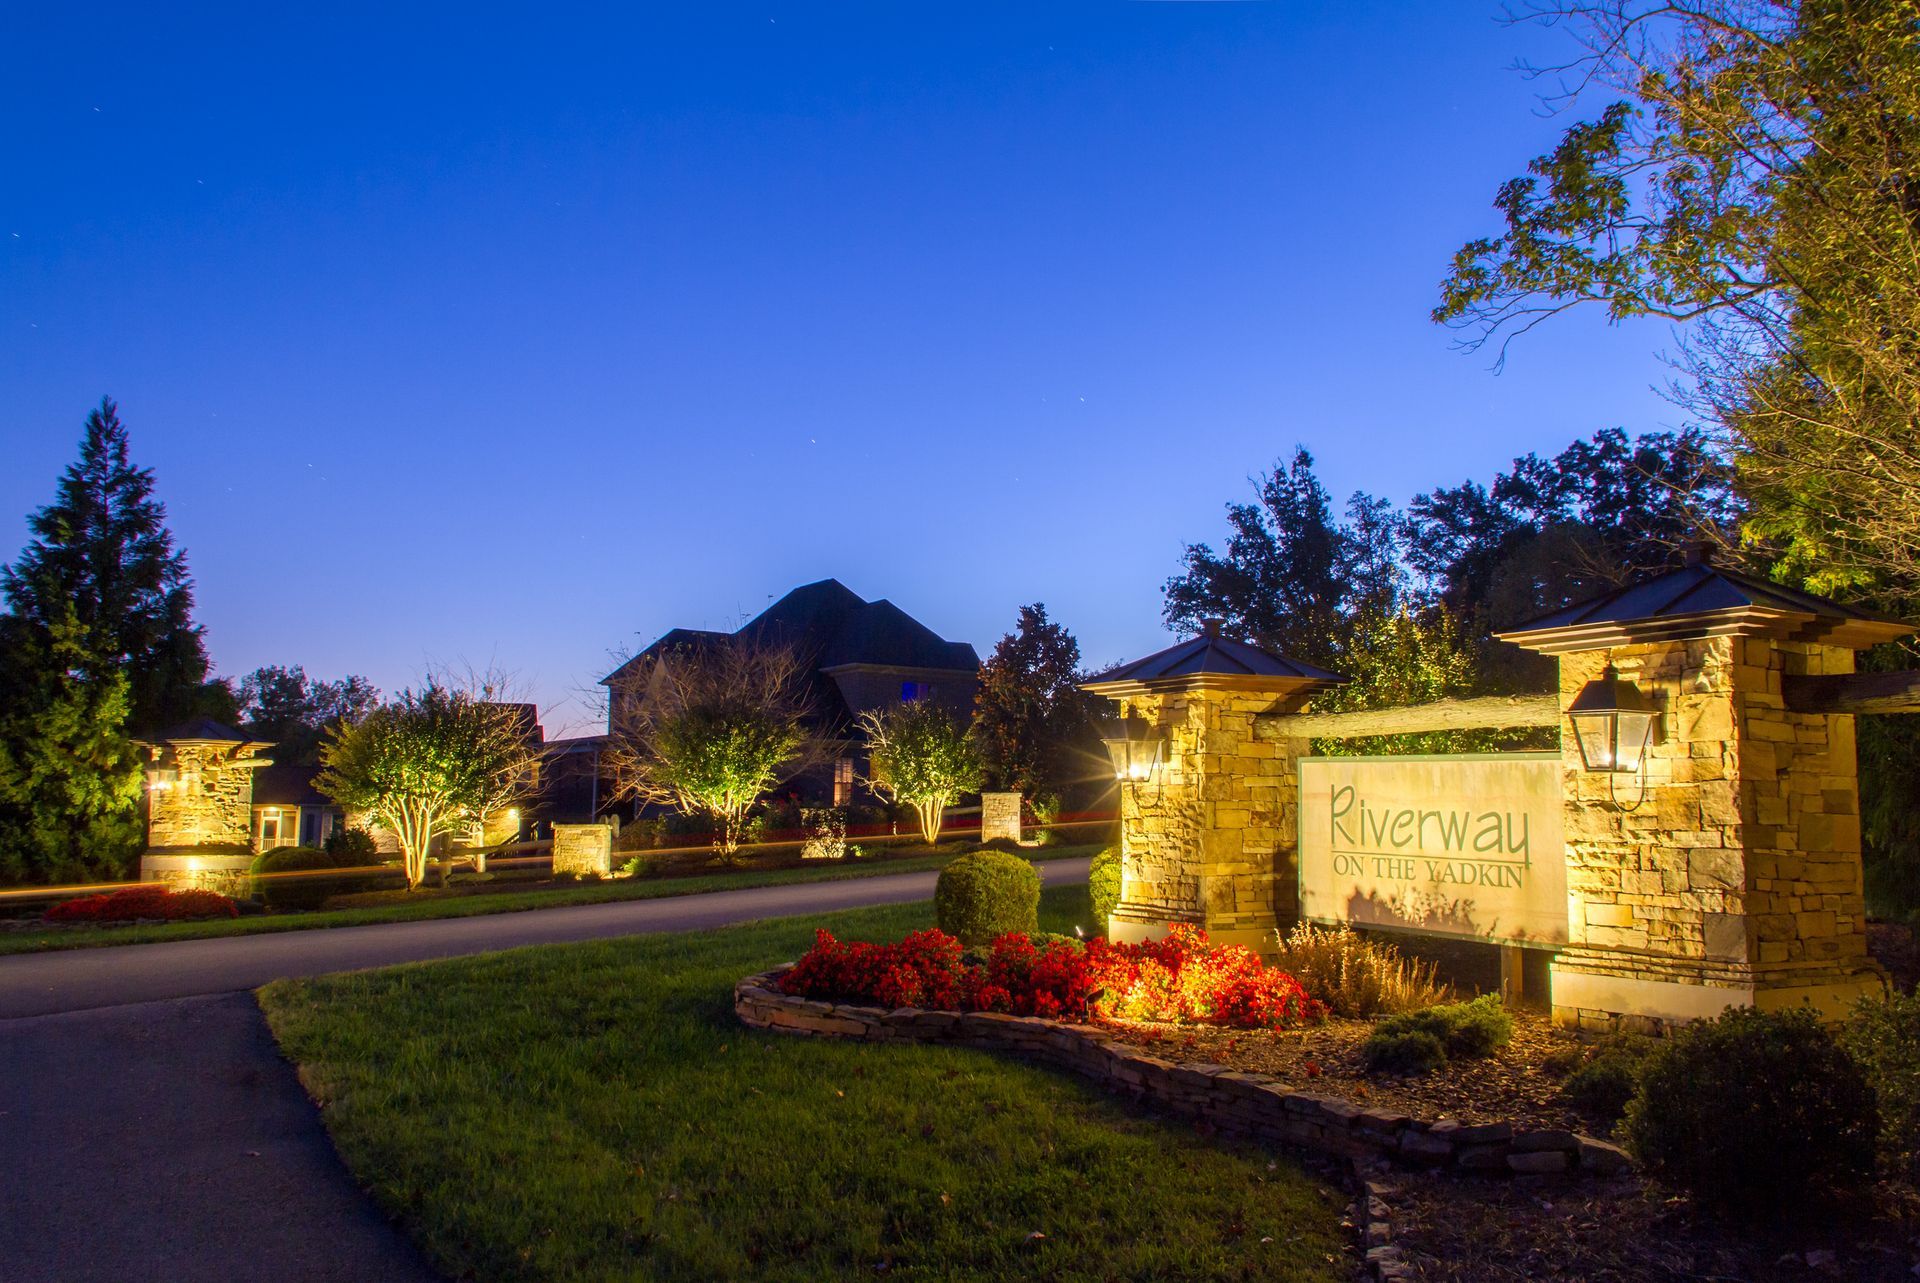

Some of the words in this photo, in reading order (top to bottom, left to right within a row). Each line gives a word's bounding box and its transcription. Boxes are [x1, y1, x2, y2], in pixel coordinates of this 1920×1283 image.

[1330, 783, 1530, 869] Riverway
[1333, 854, 1364, 877] ON
[1371, 857, 1416, 881] THE
[1424, 860, 1522, 889] YADKIN
